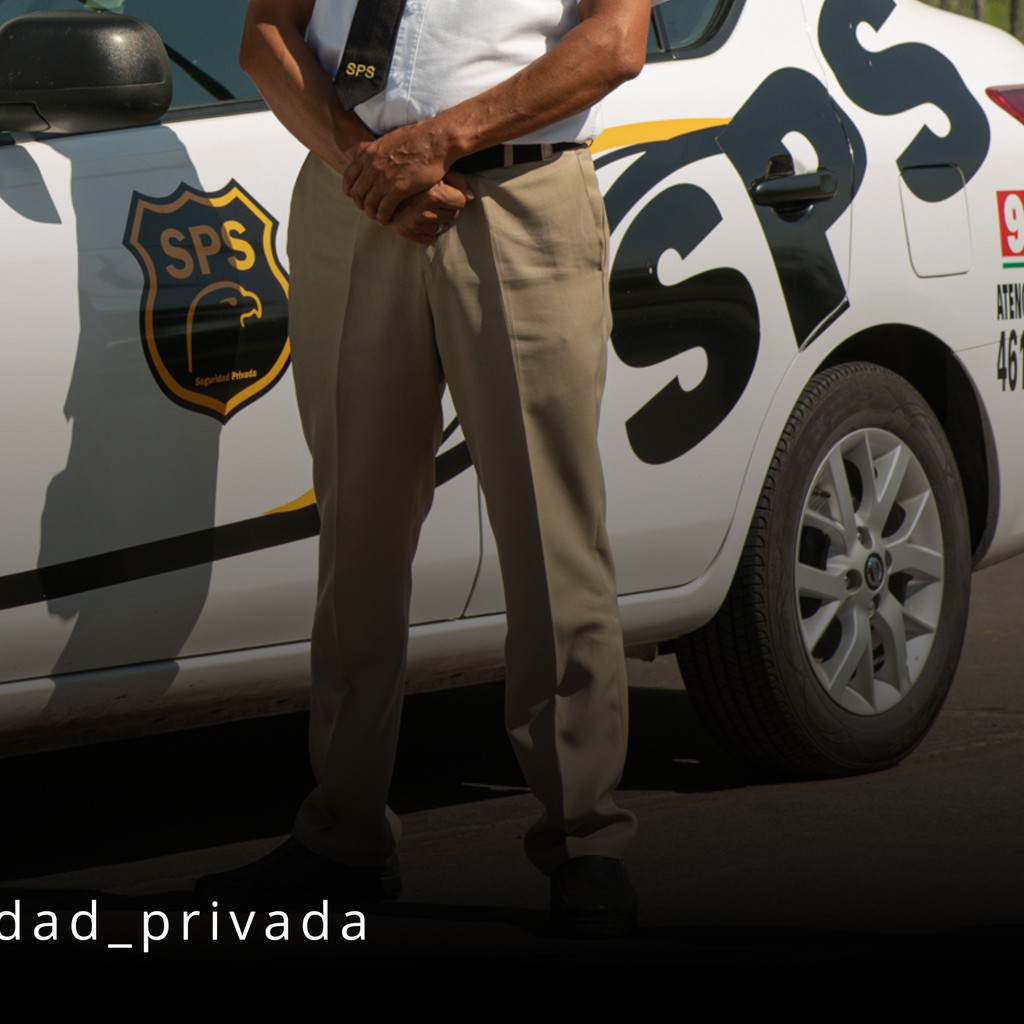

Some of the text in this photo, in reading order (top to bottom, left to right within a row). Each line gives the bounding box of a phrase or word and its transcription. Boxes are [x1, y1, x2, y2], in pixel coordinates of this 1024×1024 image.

[346, 62, 375, 79] SPS
[160, 220, 256, 279] SPS
[997, 283, 1024, 320] ATEN
[231, 369, 257, 381] Privada
